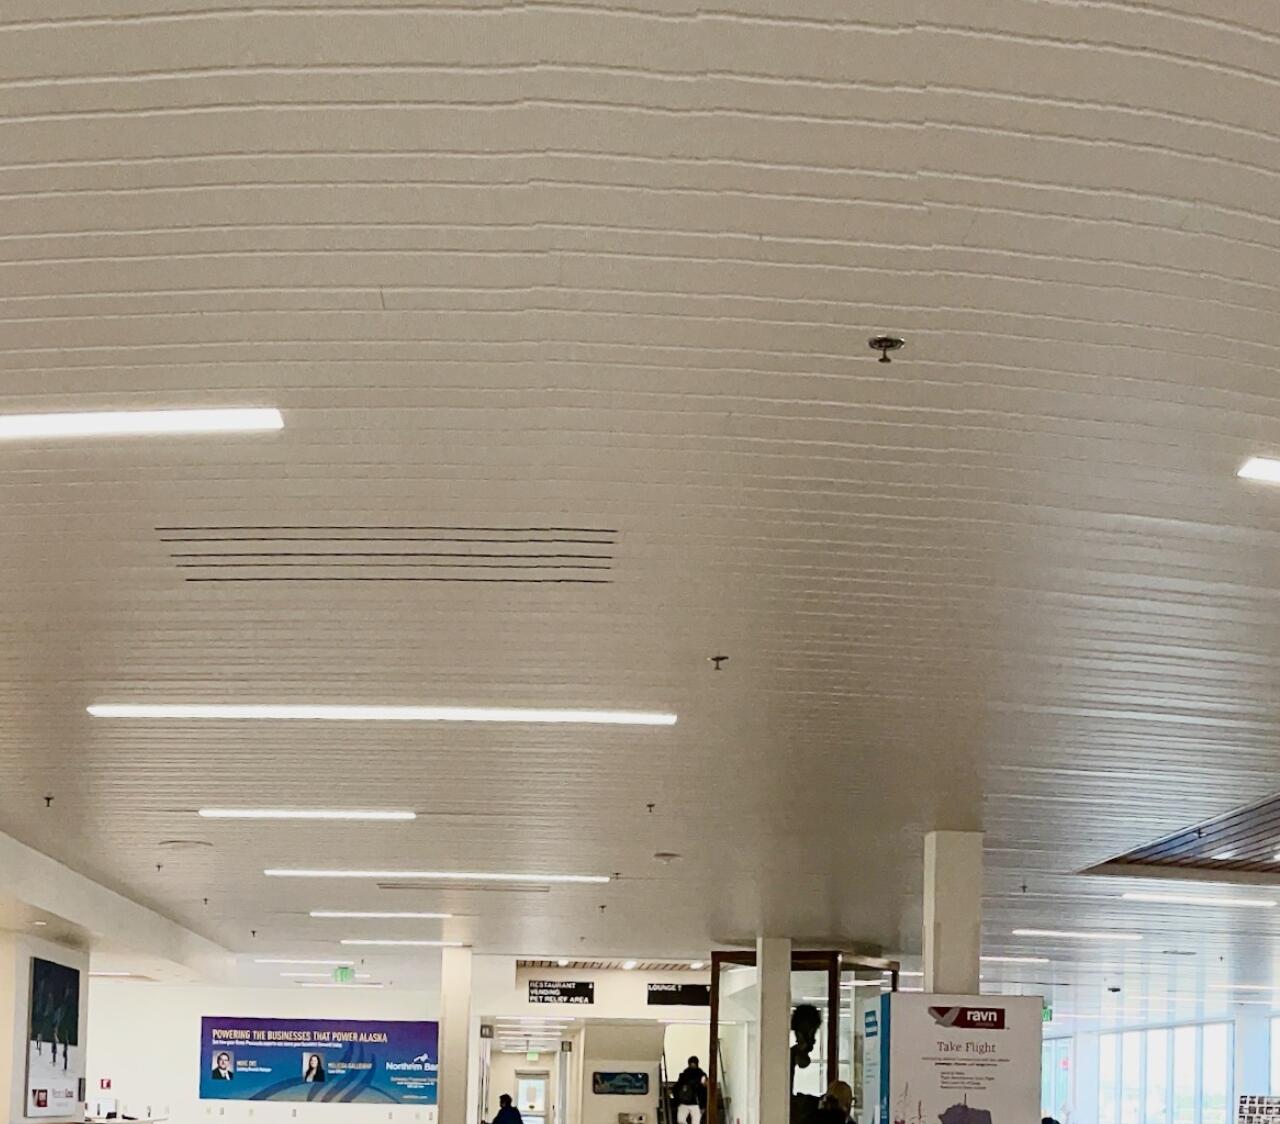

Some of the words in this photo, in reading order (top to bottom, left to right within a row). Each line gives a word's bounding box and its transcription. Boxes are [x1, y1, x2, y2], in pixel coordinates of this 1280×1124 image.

[966, 1010, 997, 1022] ravn
[212, 1029, 250, 1040] POWERING
[253, 1030, 266, 1040] THE
[267, 1030, 311, 1041] BUSINESSES
[314, 1031, 331, 1041] THAT
[332, 1031, 358, 1042] POWER
[359, 1032, 388, 1043] ALASKA
[936, 1041, 962, 1053] Take
[965, 1042, 996, 1054] Flight
